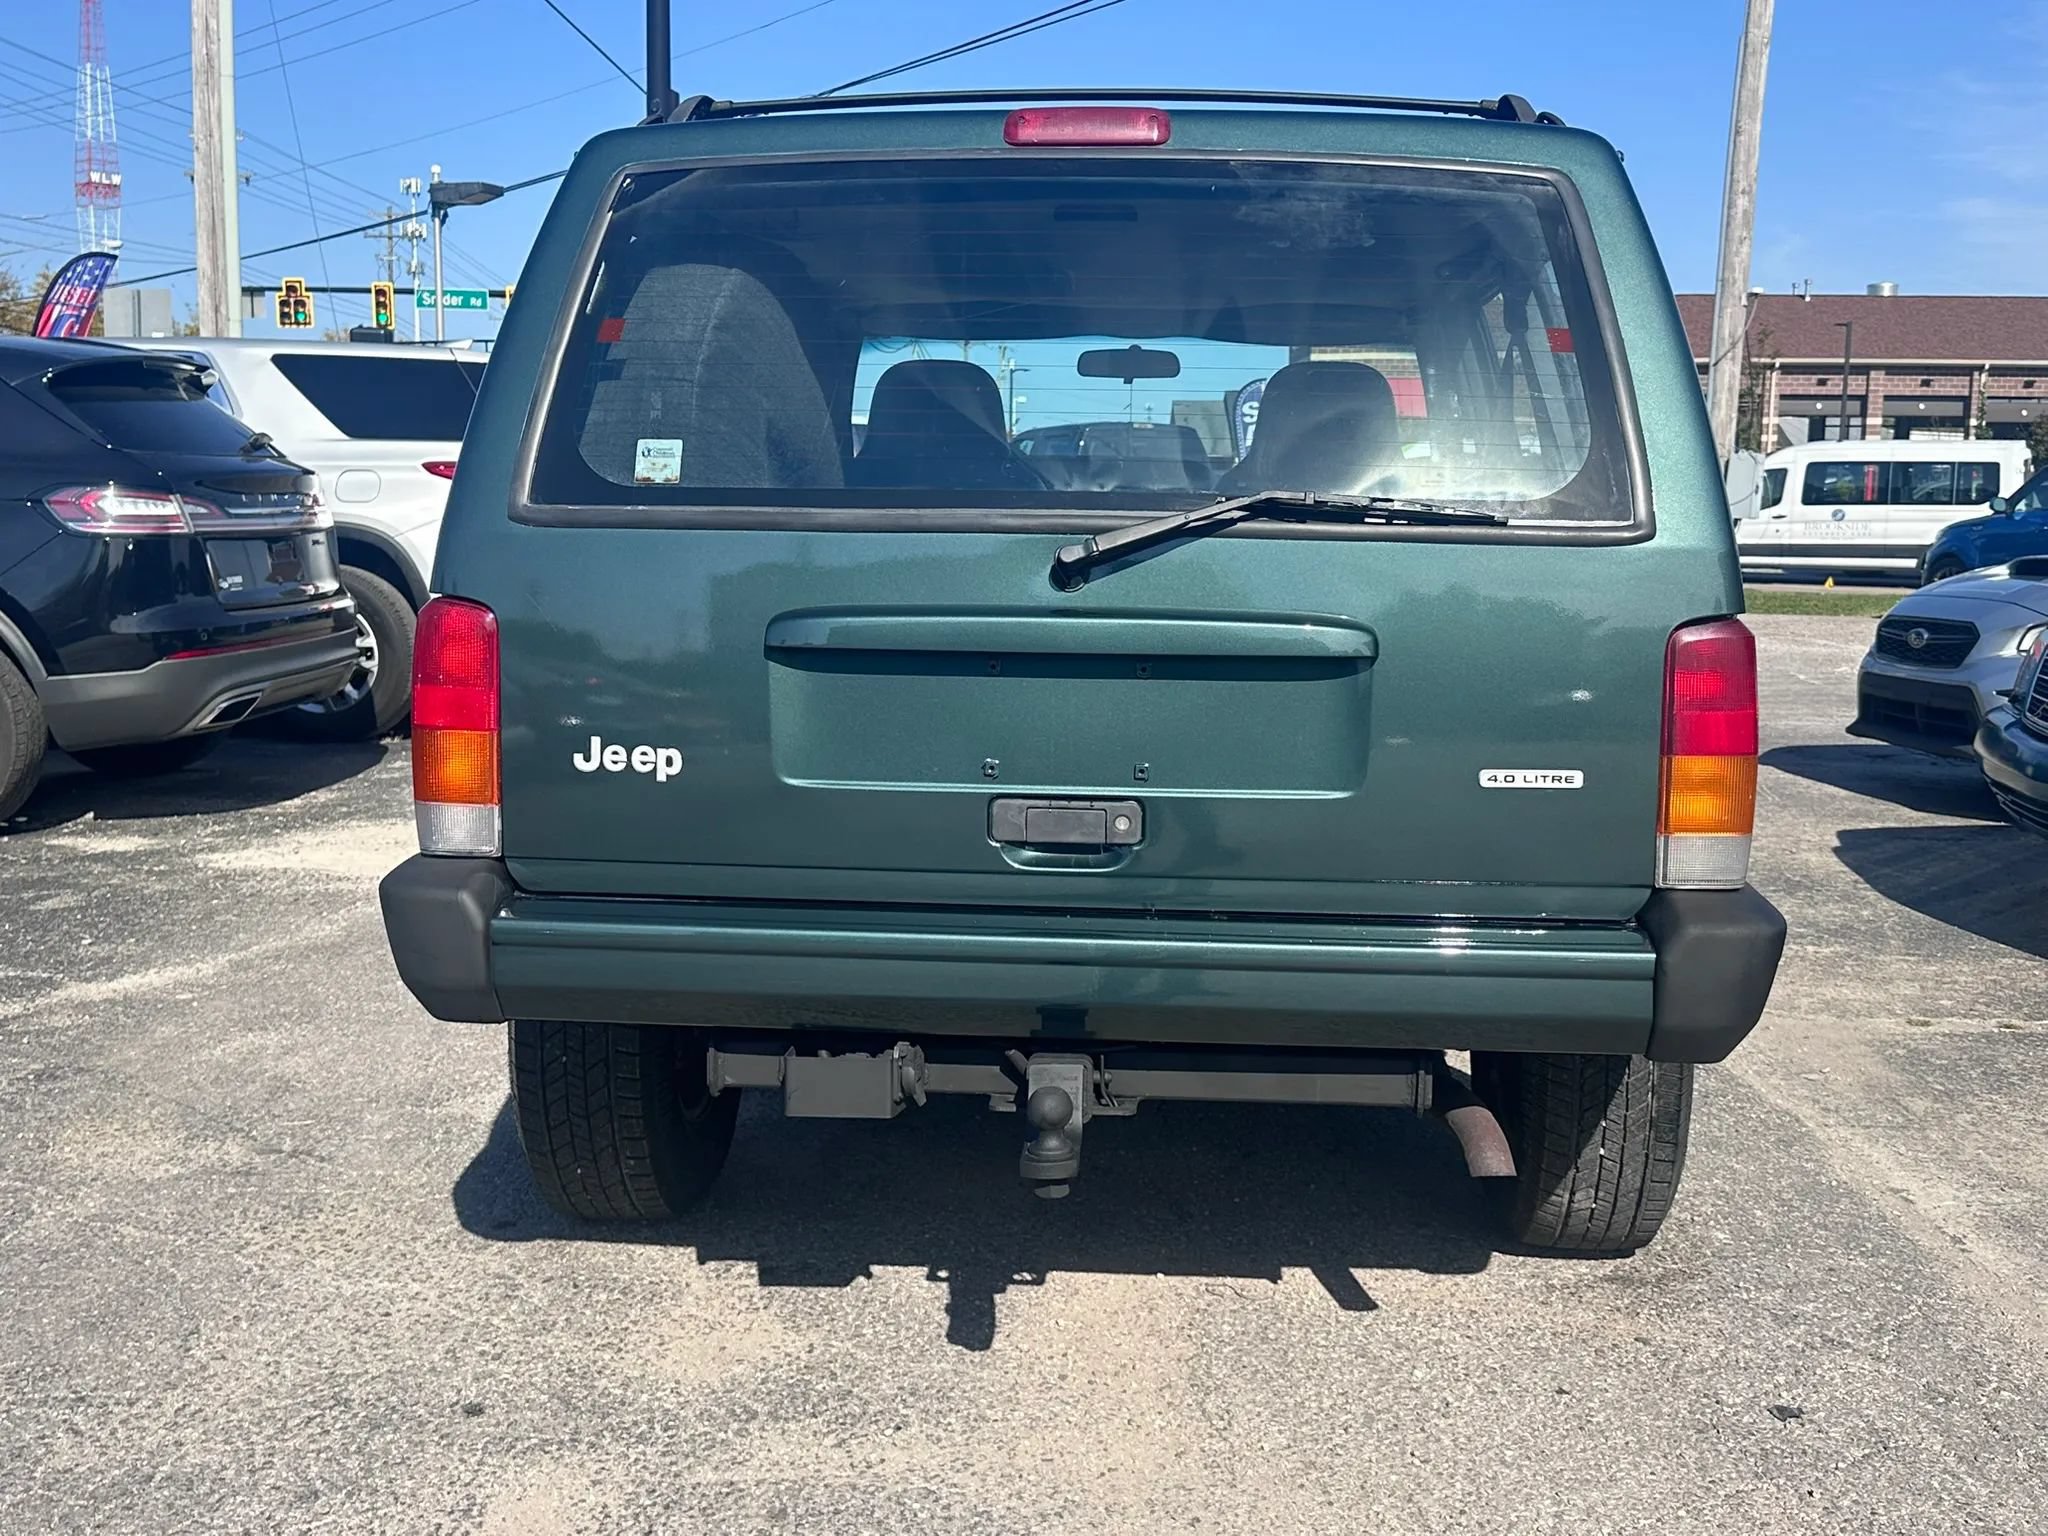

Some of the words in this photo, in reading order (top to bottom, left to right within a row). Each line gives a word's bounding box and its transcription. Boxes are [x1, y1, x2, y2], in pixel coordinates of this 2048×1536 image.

[90, 170, 122, 186] WLW
[470, 296, 482, 307] Rd
[573, 735, 683, 782] Jeep
[1487, 774, 1515, 784] 4.0
[1523, 774, 1575, 784] LITRE
